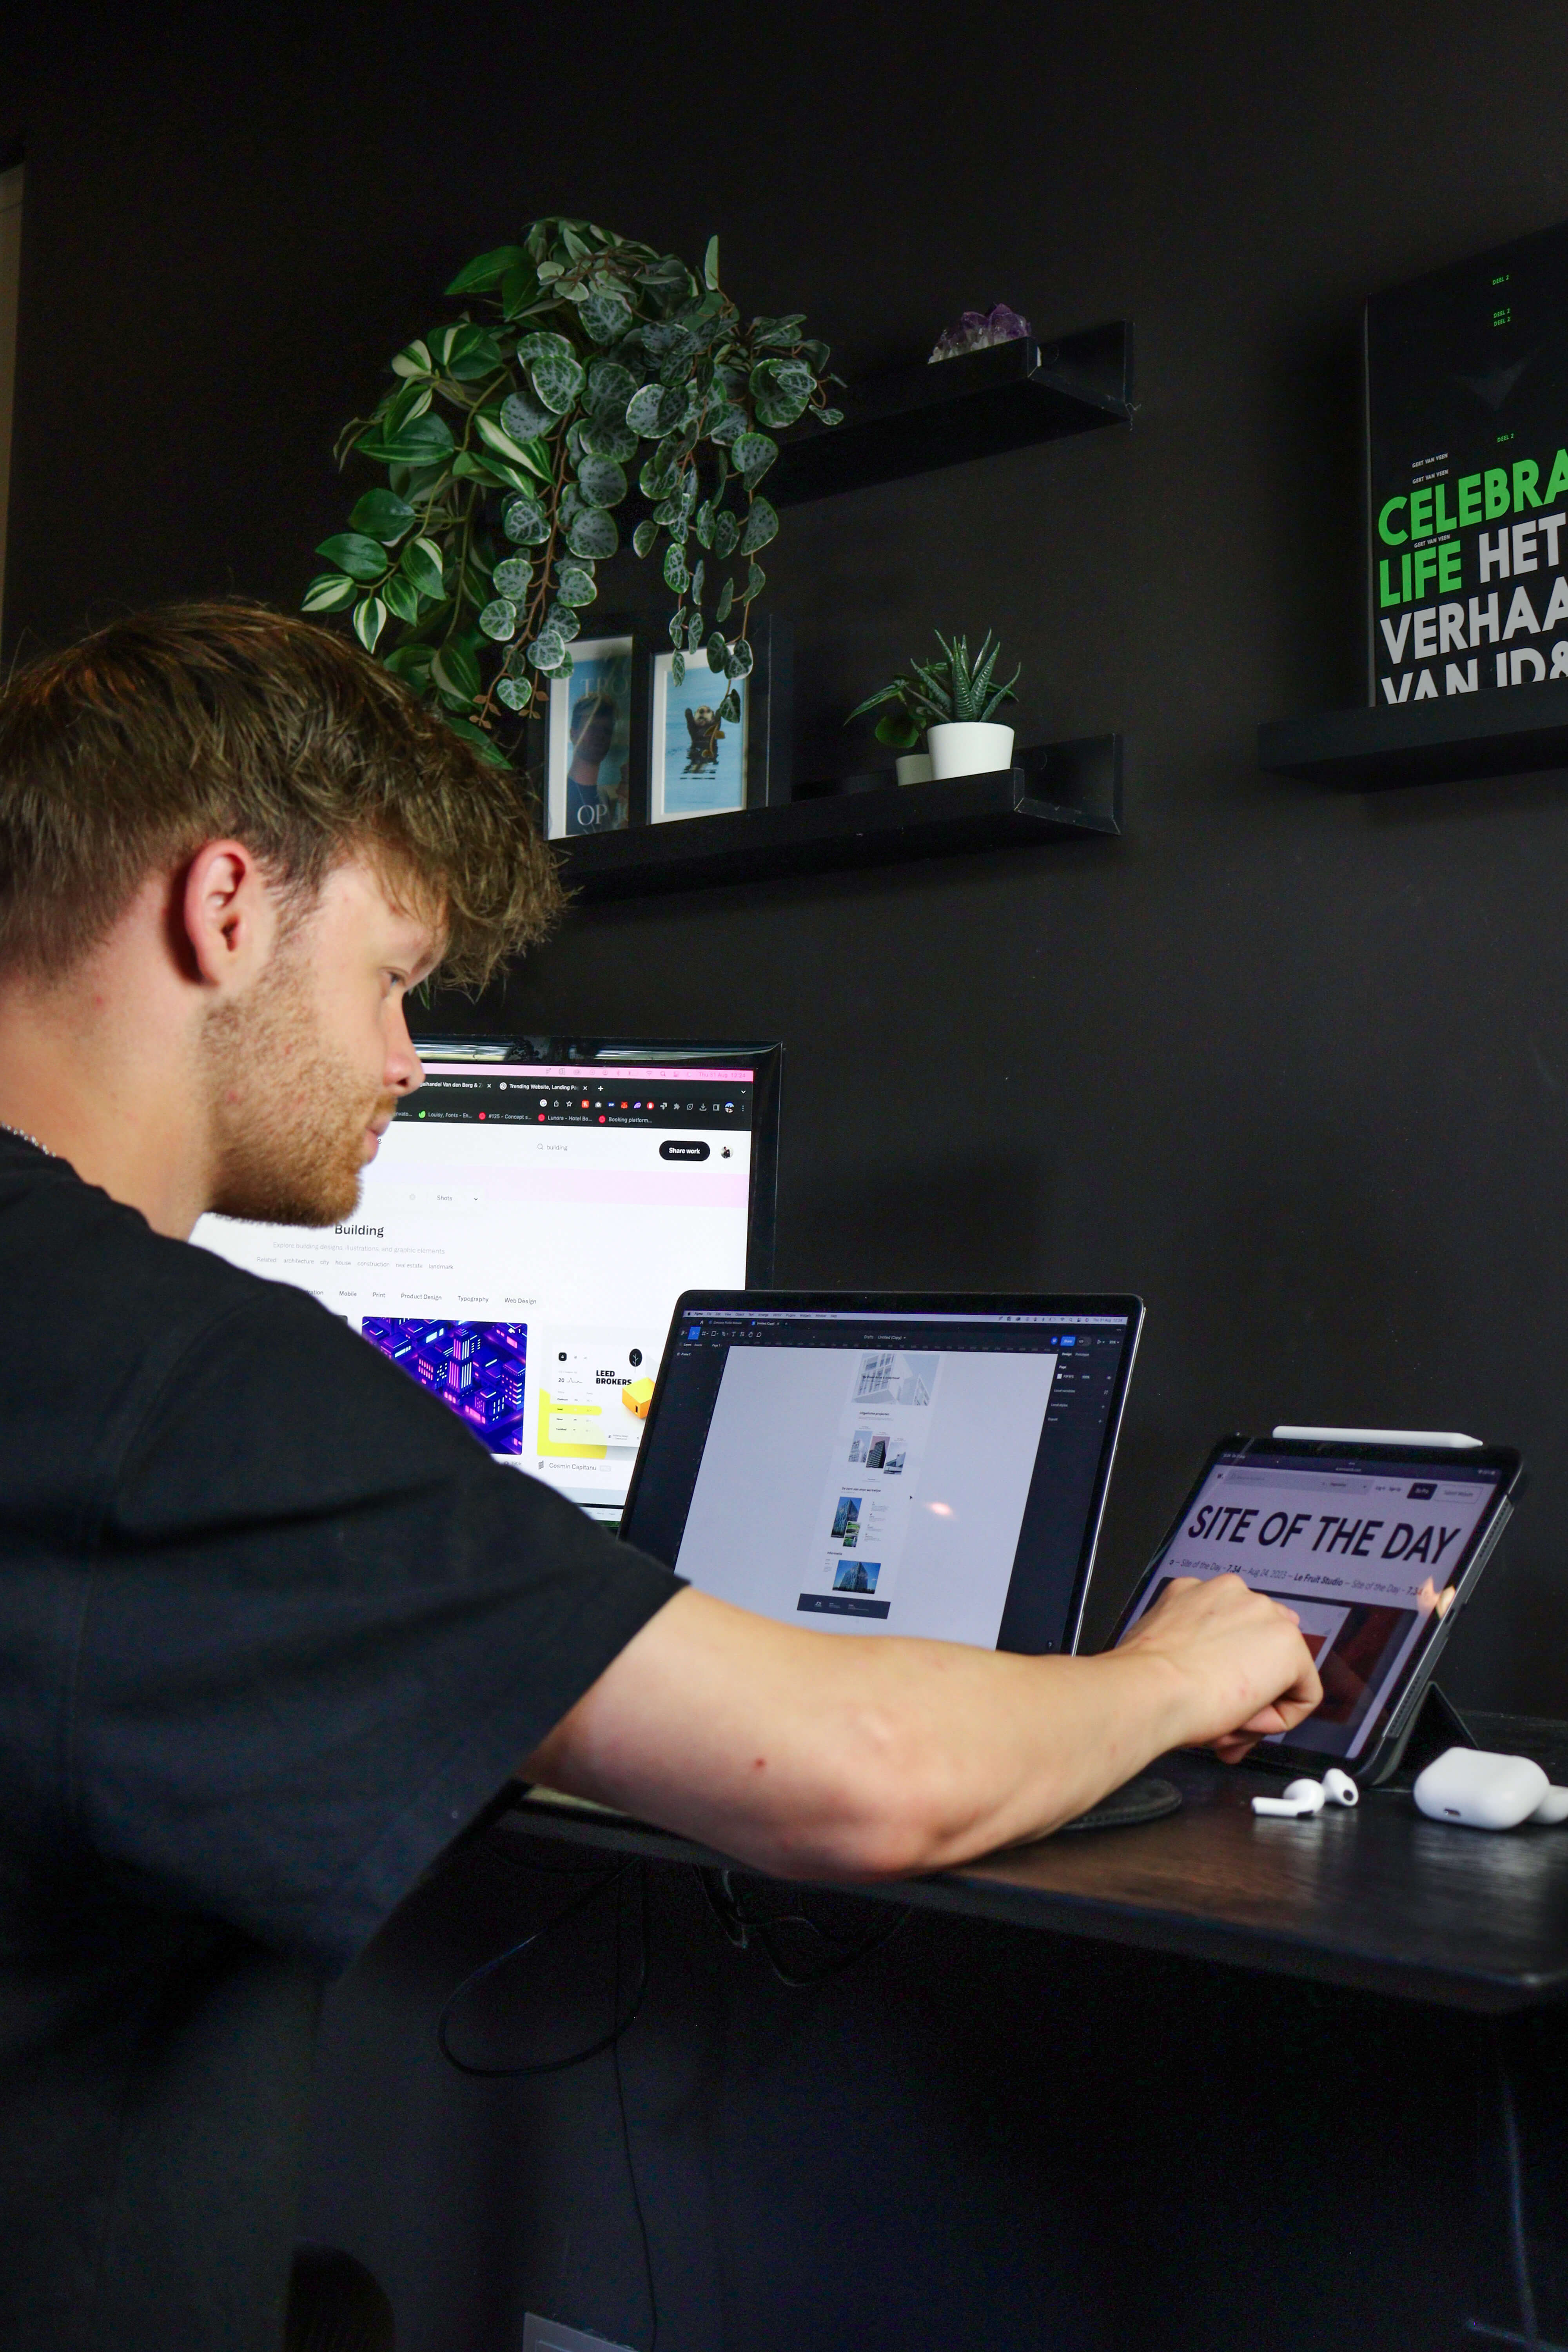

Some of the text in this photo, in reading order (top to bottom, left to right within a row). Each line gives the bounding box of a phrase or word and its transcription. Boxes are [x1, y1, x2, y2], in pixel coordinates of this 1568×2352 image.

[1492, 276, 1504, 285] DEEL
[1493, 310, 1505, 318] DEEL
[1497, 435, 1509, 443] DEEL
[1436, 469, 1449, 477] VEEN
[1378, 448, 1568, 546] CELEBRA
[1438, 534, 1450, 542] VEEN
[1379, 512, 1566, 608] LIFE HET
[1379, 576, 1568, 665] VERHAA
[1381, 658, 1478, 704] VAN
[335, 1224, 384, 1238] Building
[1188, 1505, 1462, 1564] SITE OF THE DAY
[1180, 1559, 1192, 1567] Site
[1192, 1560, 1200, 1568] of
[1200, 1561, 1210, 1570] the
[1210, 1562, 1221, 1572] Day
[1226, 1564, 1242, 1573] 7.34
[1247, 1568, 1260, 1578] Aug
[1294, 1573, 1303, 1581] Le
[1303, 1573, 1321, 1584] Fruit
[1321, 1576, 1343, 1586] Studio
[1351, 1580, 1364, 1589] Site
[1365, 1581, 1374, 1590] of
[1373, 1583, 1386, 1592] the
[1386, 1584, 1400, 1595] Day
